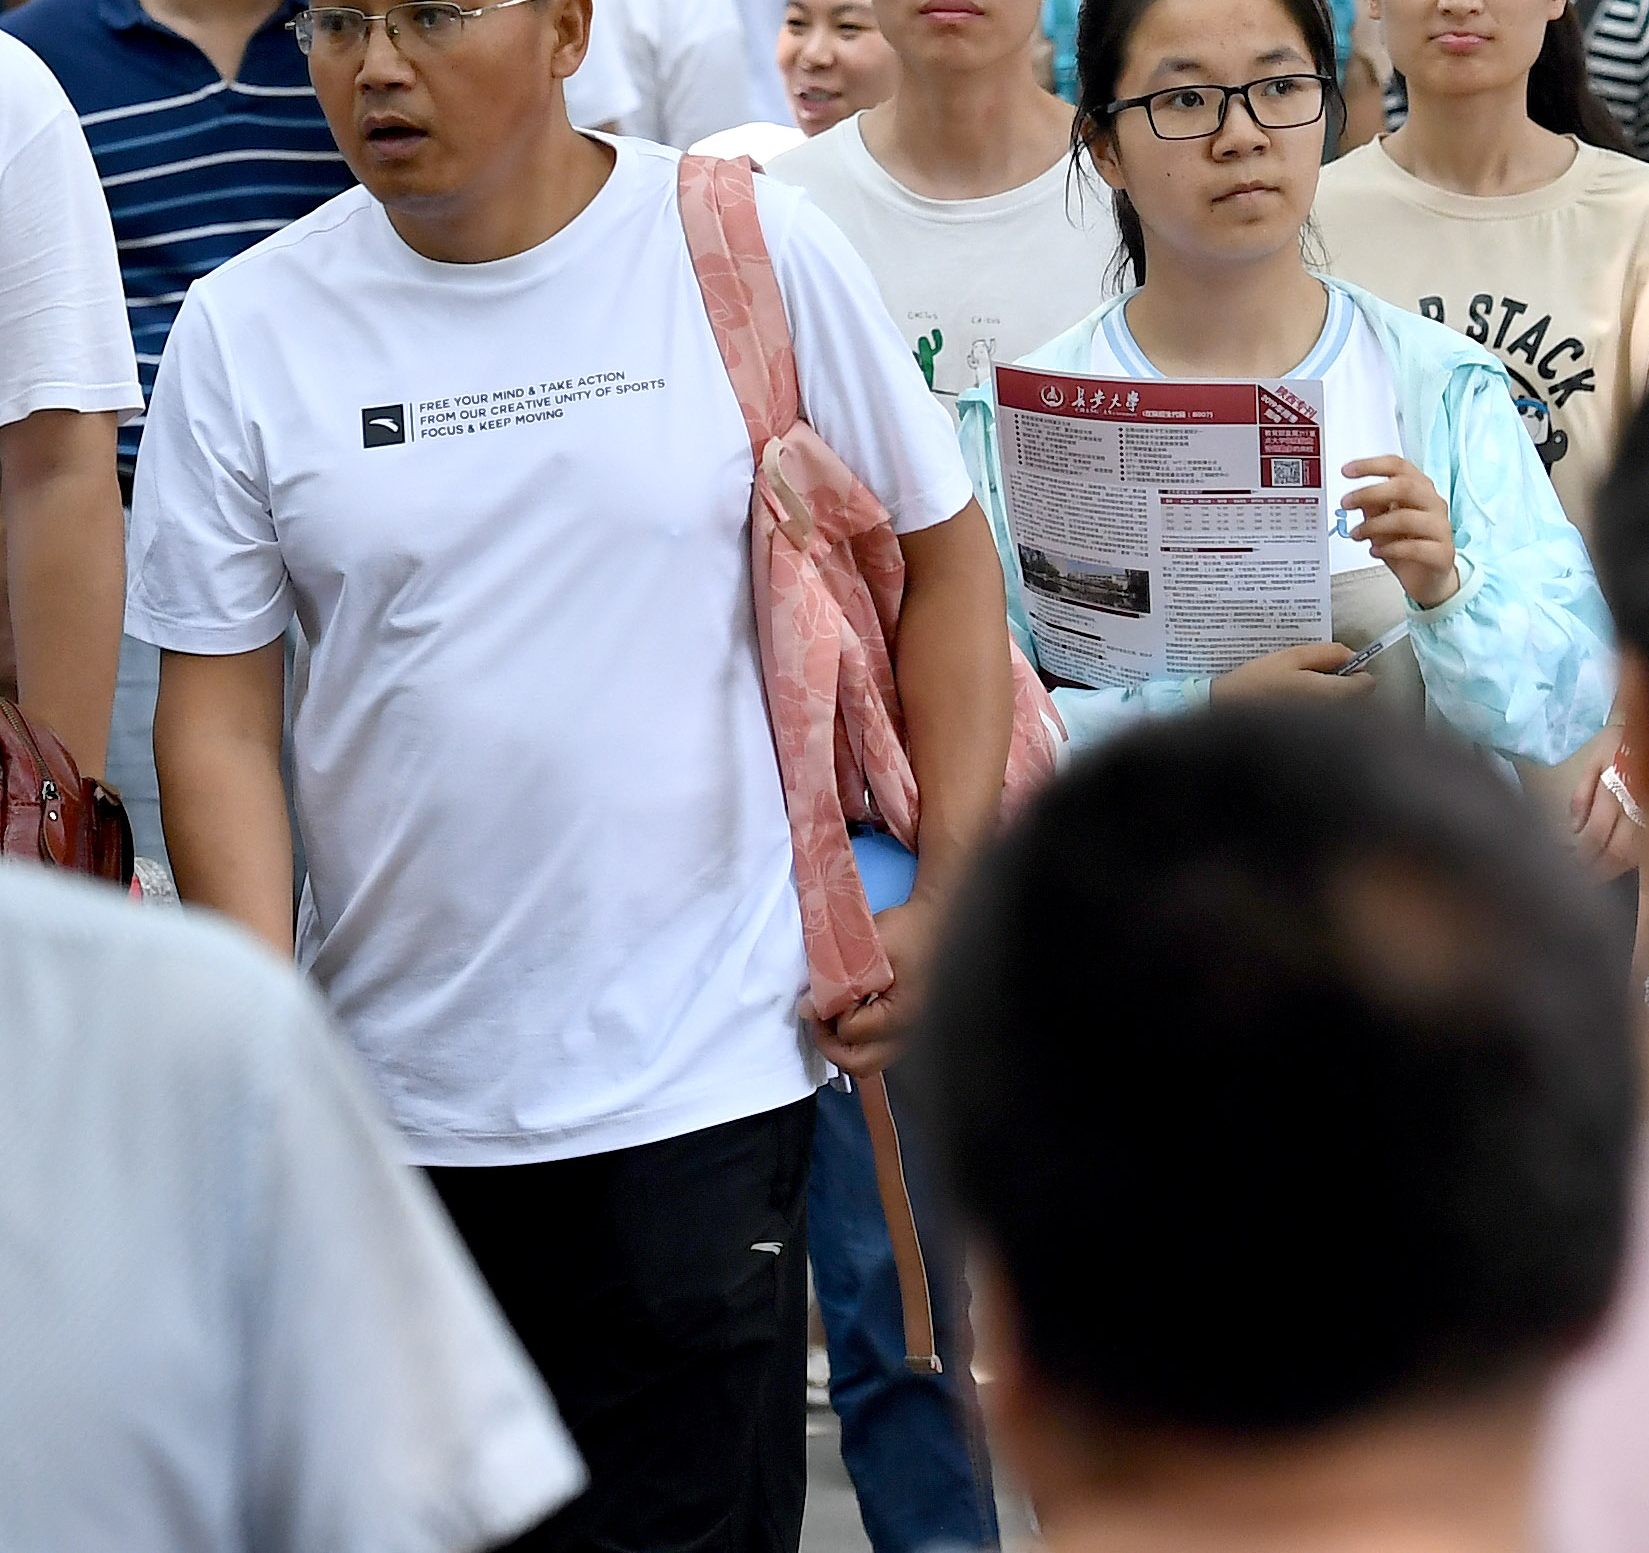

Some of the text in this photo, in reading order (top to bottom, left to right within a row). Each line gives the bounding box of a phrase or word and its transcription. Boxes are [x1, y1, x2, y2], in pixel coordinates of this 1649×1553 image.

[1466, 293, 1595, 409] STACK
[420, 371, 625, 413] FREE YOUR MIND & TAKE ACTION
[420, 378, 665, 425] FROM OUR CREATIVE UNITY OF SPORTS
[421, 408, 564, 439] FOCUS & KEEP MOVING
